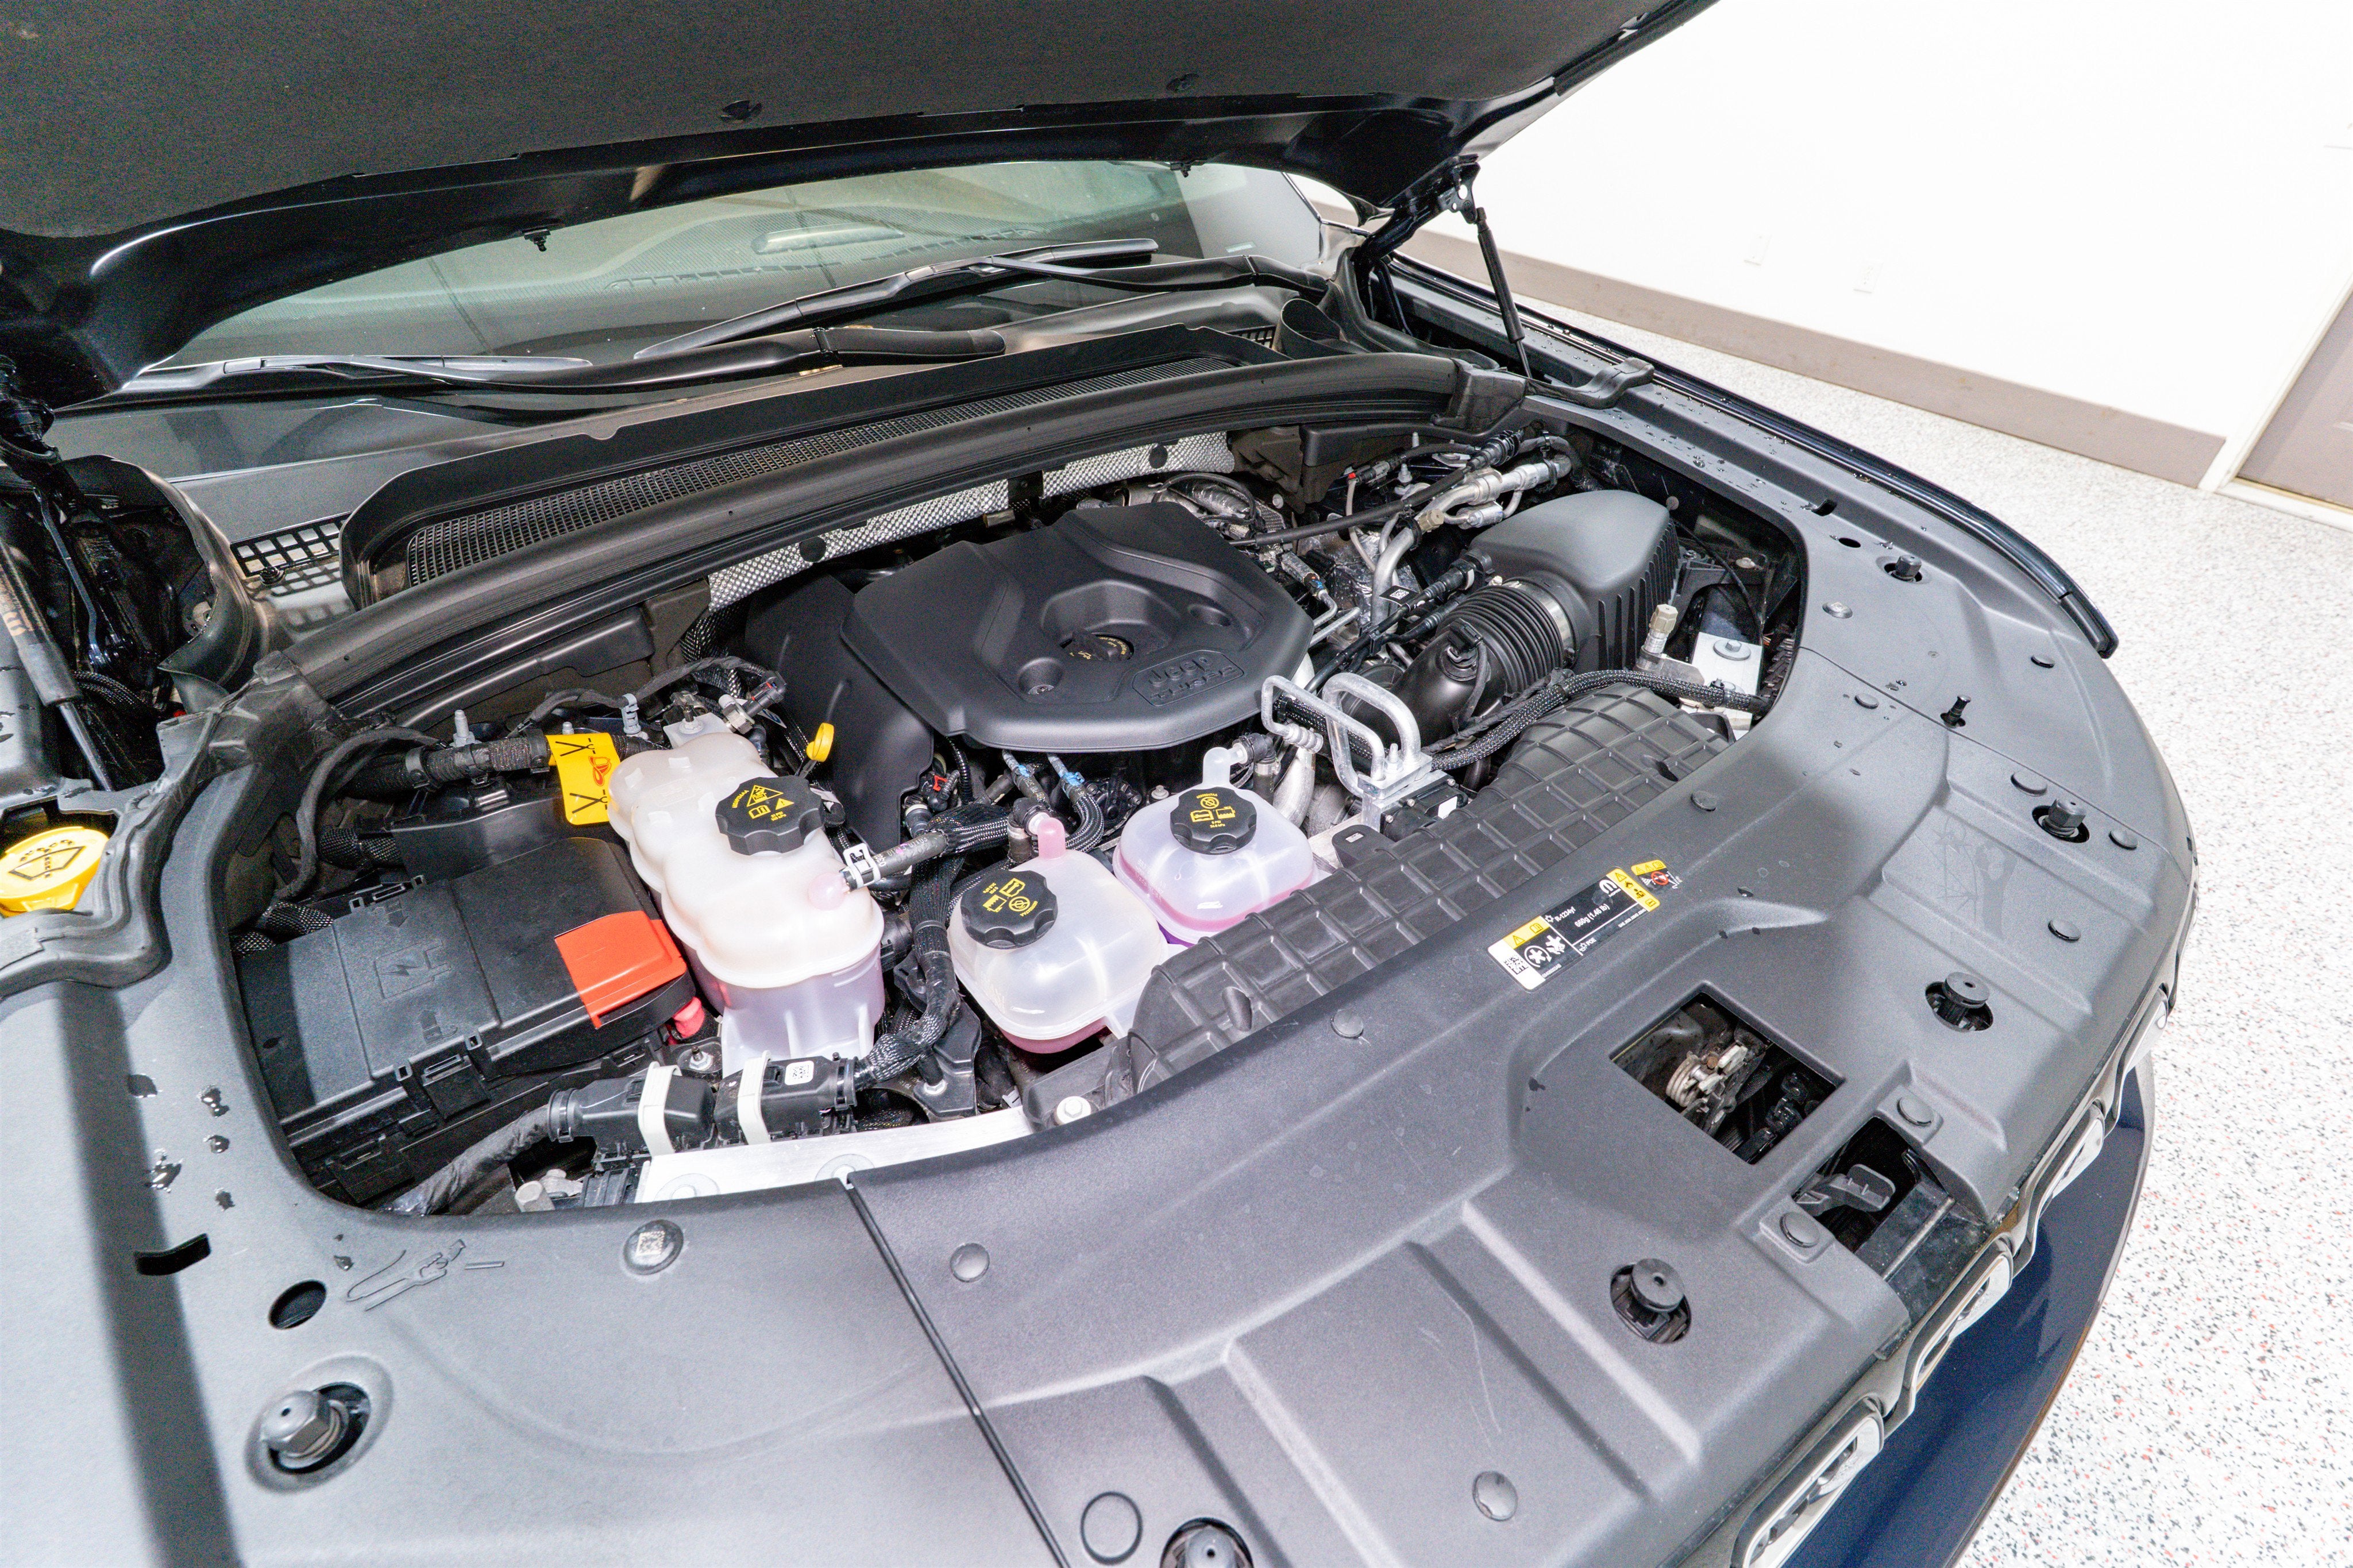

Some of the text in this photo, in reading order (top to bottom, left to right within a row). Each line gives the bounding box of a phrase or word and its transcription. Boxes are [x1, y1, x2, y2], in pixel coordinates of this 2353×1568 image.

[1148, 656, 1213, 686] Jeep
[1554, 906, 1576, 922] R-1234yf
[1574, 903, 1610, 928] 660g (1.46 lb)
[1586, 937, 1597, 946] POE
